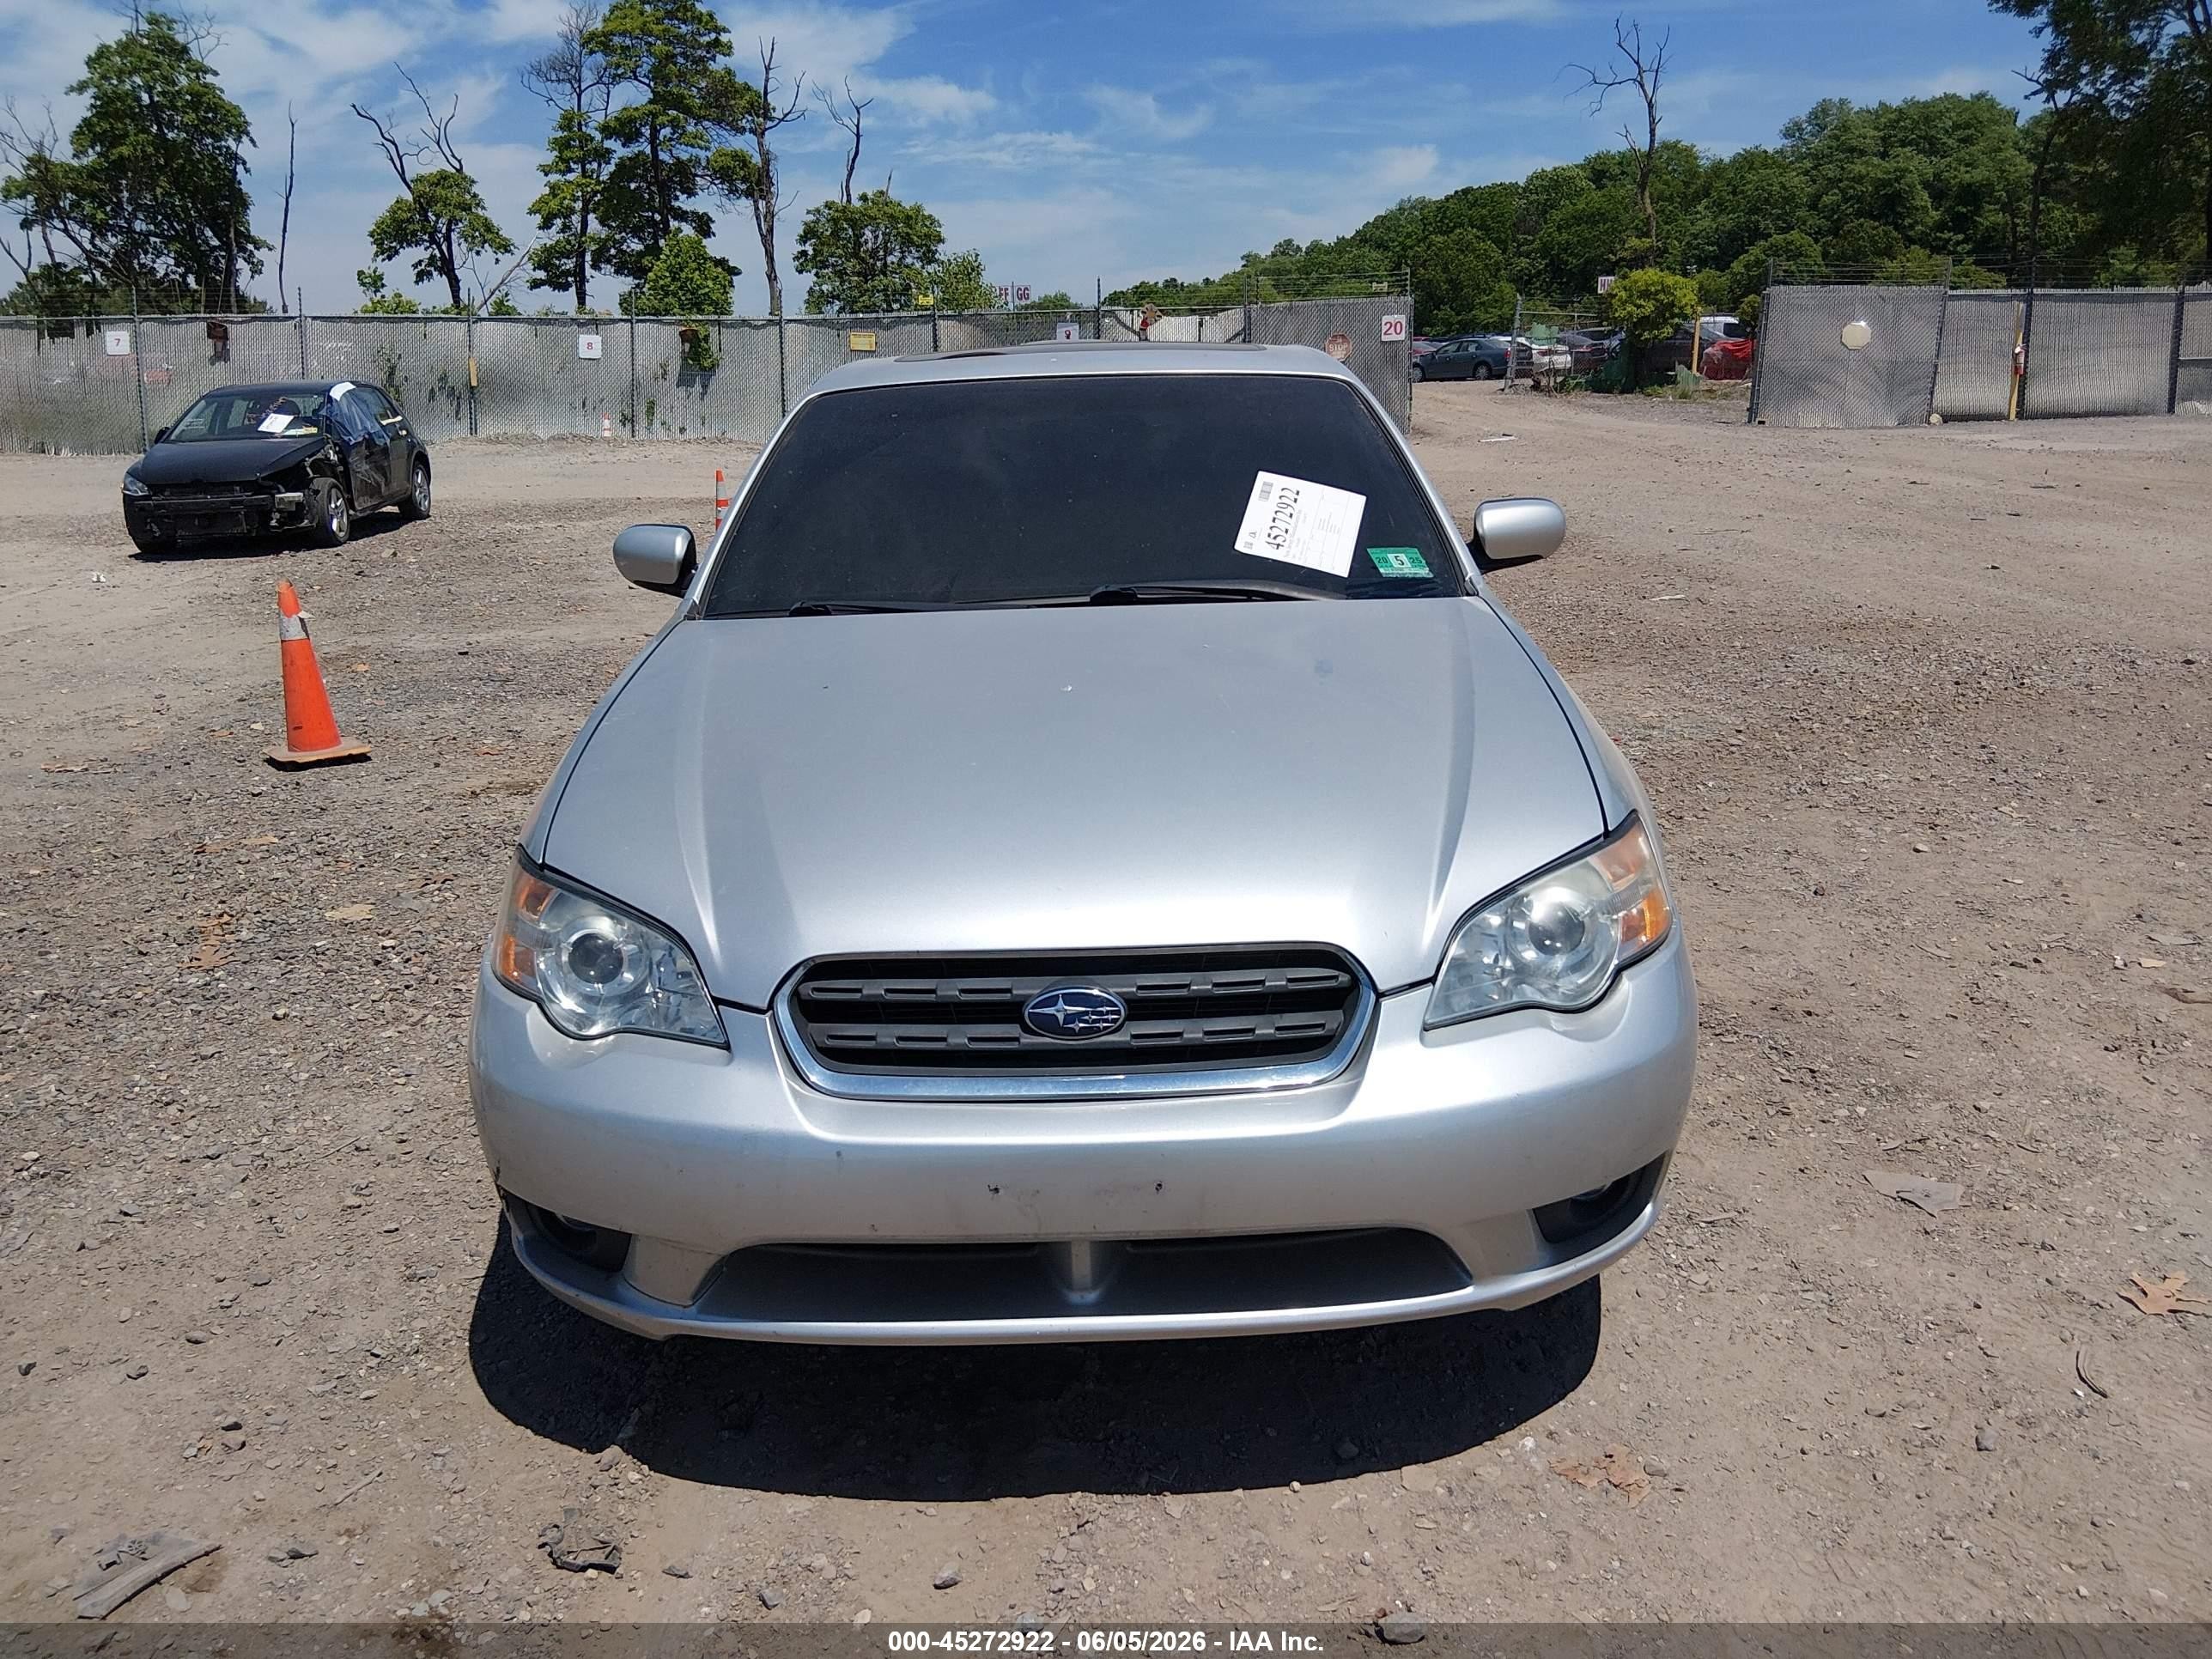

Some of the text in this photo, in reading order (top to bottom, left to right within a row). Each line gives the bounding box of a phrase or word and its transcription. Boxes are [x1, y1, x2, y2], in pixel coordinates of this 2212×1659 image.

[1017, 287, 1030, 301] GG
[1383, 321, 1403, 336] 20
[113, 337, 121, 347] 7
[586, 342, 593, 350] 8
[1328, 343, 1348, 352] STOP
[1265, 487, 1300, 550] 45272922
[1394, 556, 1405, 566] 5
